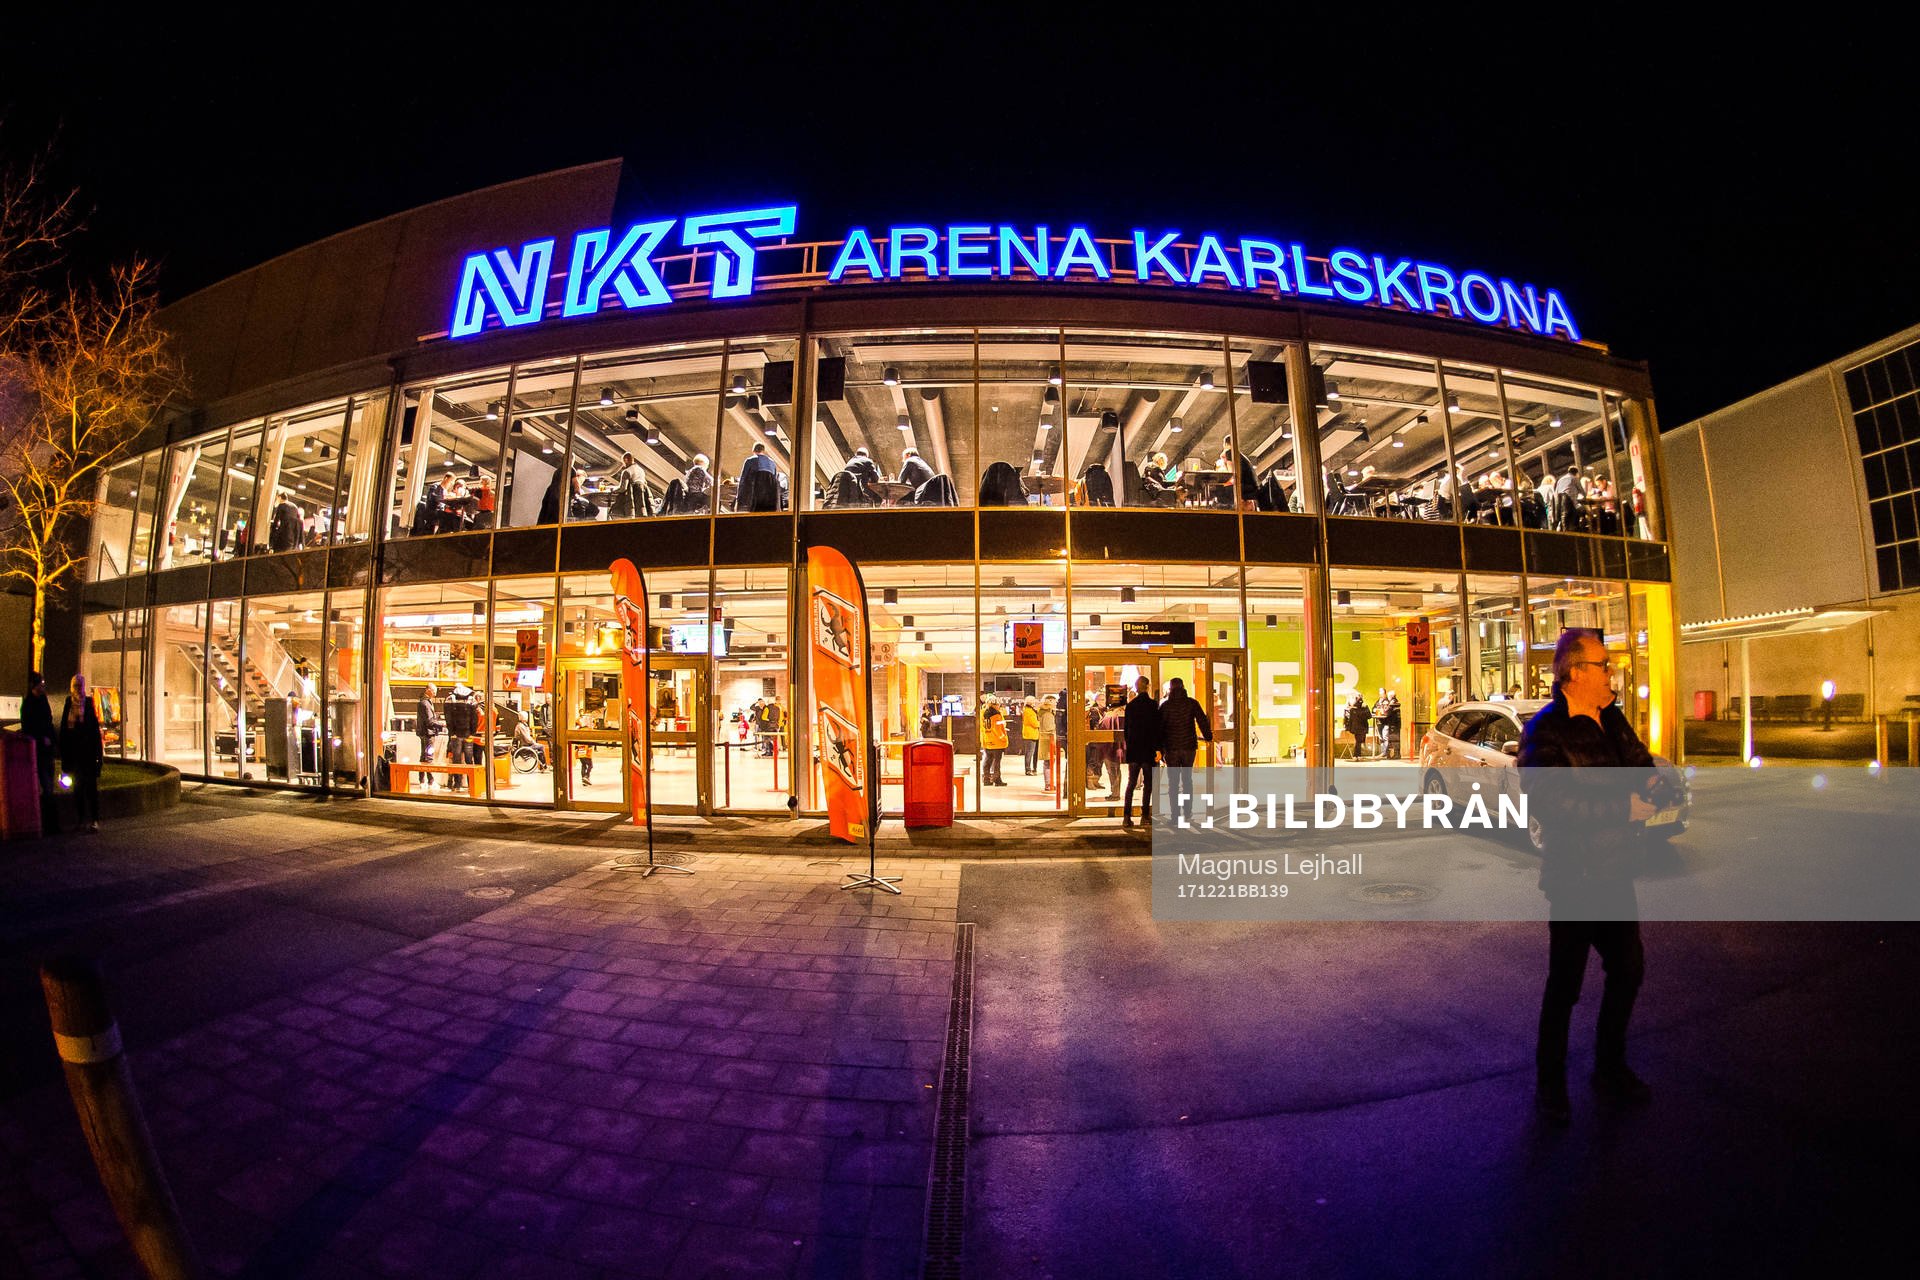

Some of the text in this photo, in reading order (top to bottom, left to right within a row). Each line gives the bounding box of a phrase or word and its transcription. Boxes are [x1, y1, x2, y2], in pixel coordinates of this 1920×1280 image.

[450, 205, 1580, 340] NKT ARENA KARLSKRONA
[410, 643, 436, 653] MAXI
